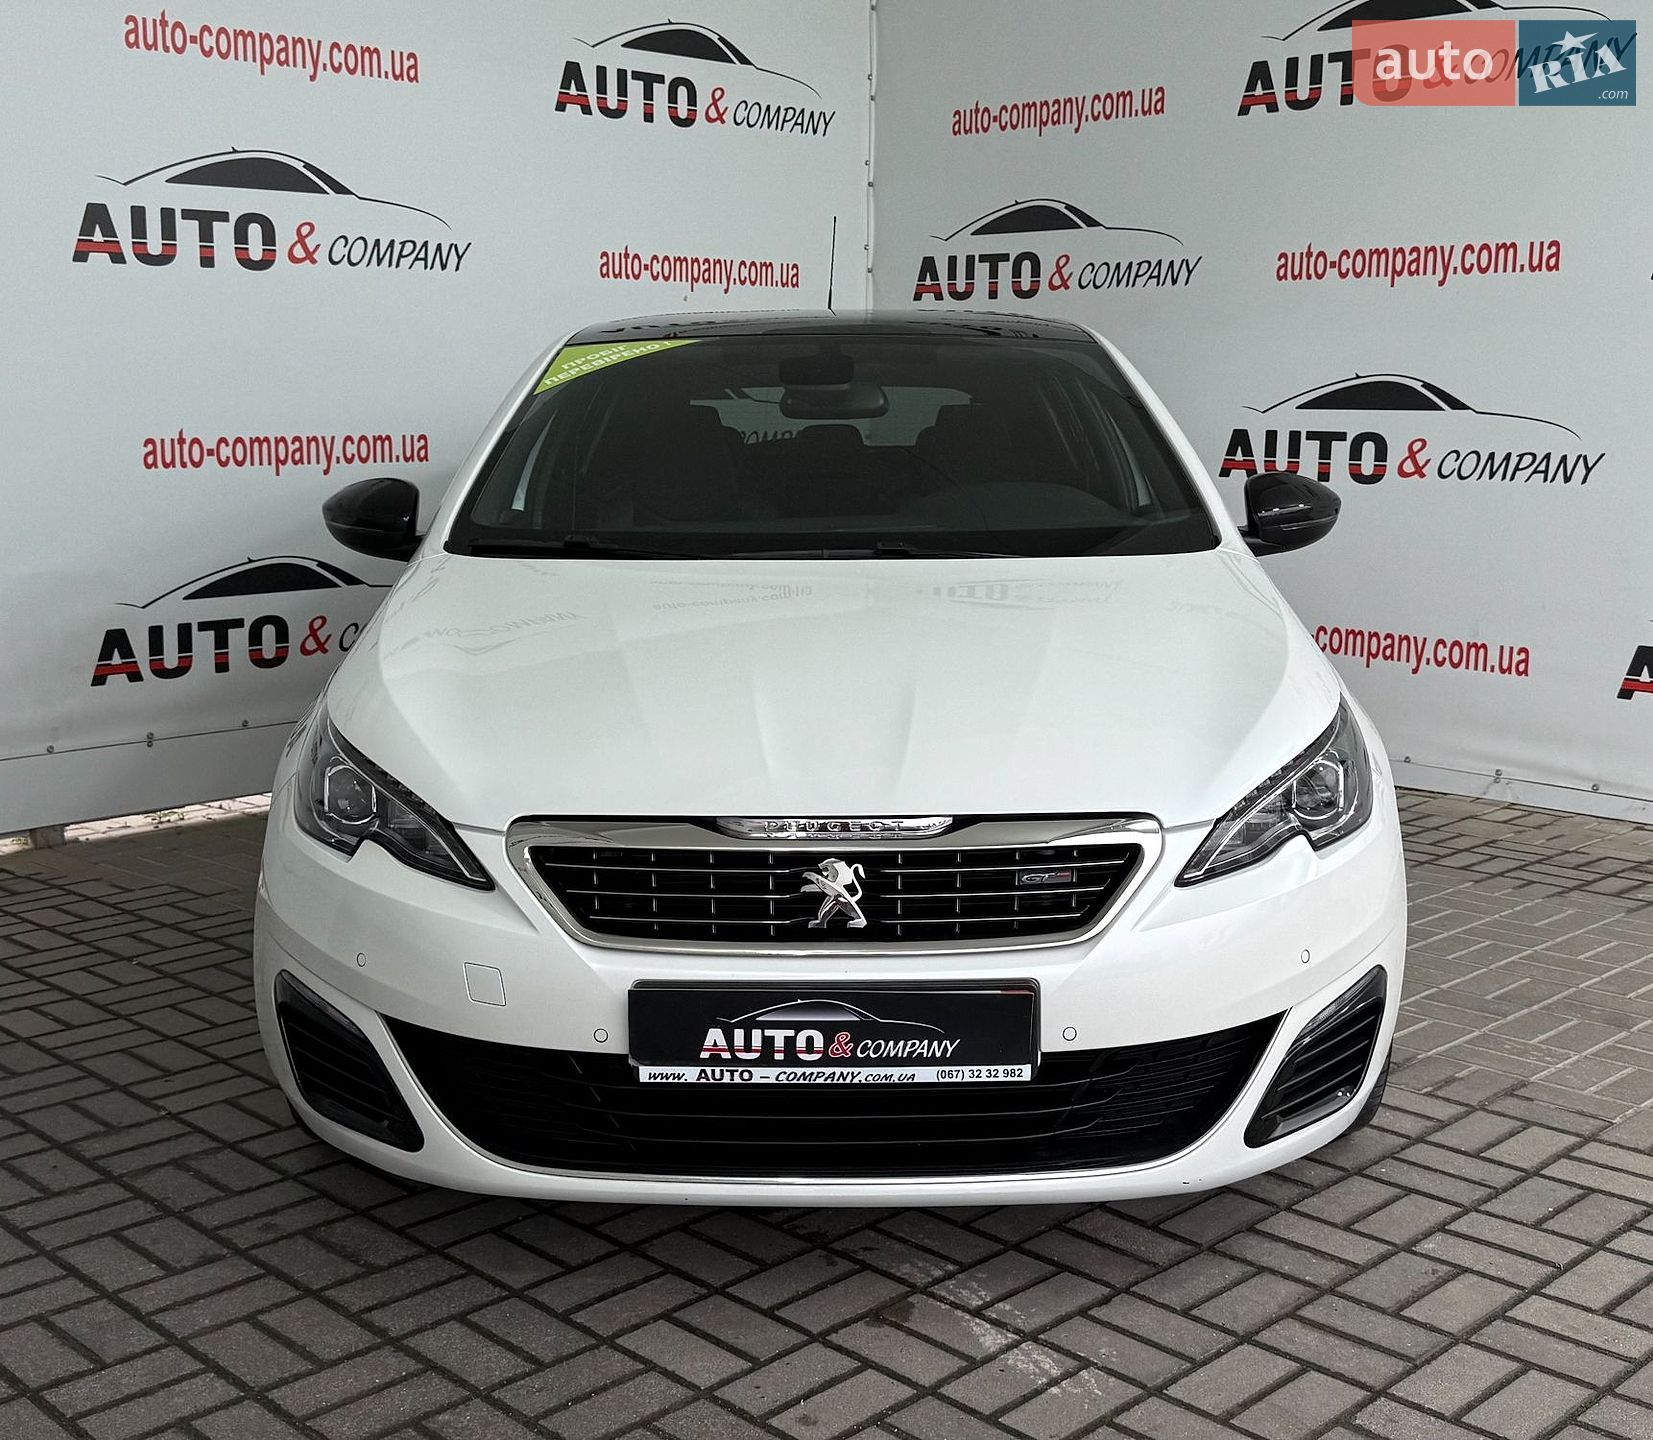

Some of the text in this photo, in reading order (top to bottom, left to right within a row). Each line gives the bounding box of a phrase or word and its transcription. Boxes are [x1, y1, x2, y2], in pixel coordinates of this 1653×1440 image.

[123, 9, 421, 84] auto-company.com.ua
[555, 60, 836, 137] AUTO & COMPANY
[951, 86, 1166, 137] auto-company.com.ua
[72, 202, 472, 272] AUTO & COMPANY
[599, 245, 800, 294] auto-company.com.ua
[912, 251, 1203, 301] AUTO & COMPANY
[1275, 239, 1562, 288] auto-company.com.ua
[142, 429, 430, 477] auto-company.com.ua
[1218, 428, 1606, 486] AUTO & COMPANY
[90, 614, 290, 687] AUTO
[299, 615, 333, 657] &
[700, 1028, 960, 1061] AUTO & COMPANY
[695, 1069, 754, 1082] AUTO
[935, 1068, 965, 1081] (067)
[968, 1068, 983, 1080] 32
[985, 1068, 1000, 1080] 32
[1002, 1067, 1024, 1079] 982
